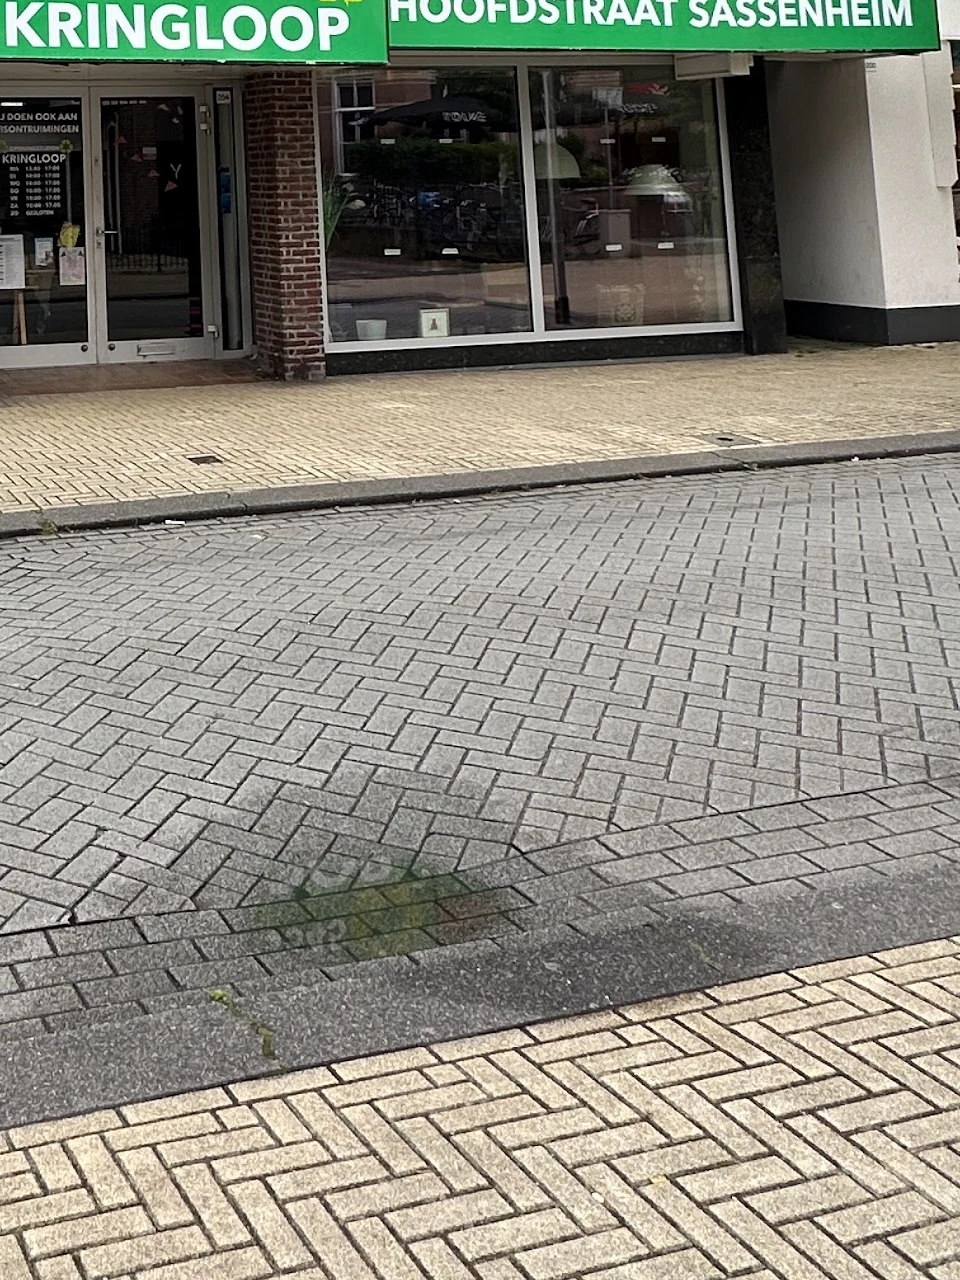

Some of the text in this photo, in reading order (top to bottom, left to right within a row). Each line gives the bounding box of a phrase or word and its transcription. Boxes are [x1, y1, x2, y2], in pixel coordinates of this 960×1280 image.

[4, 0, 351, 52] KRINGLOOP
[6, 113, 33, 121] DOEN
[35, 113, 57, 121] OOK
[57, 113, 78, 121] AAN
[2, 154, 66, 163] KRINGLOOP
